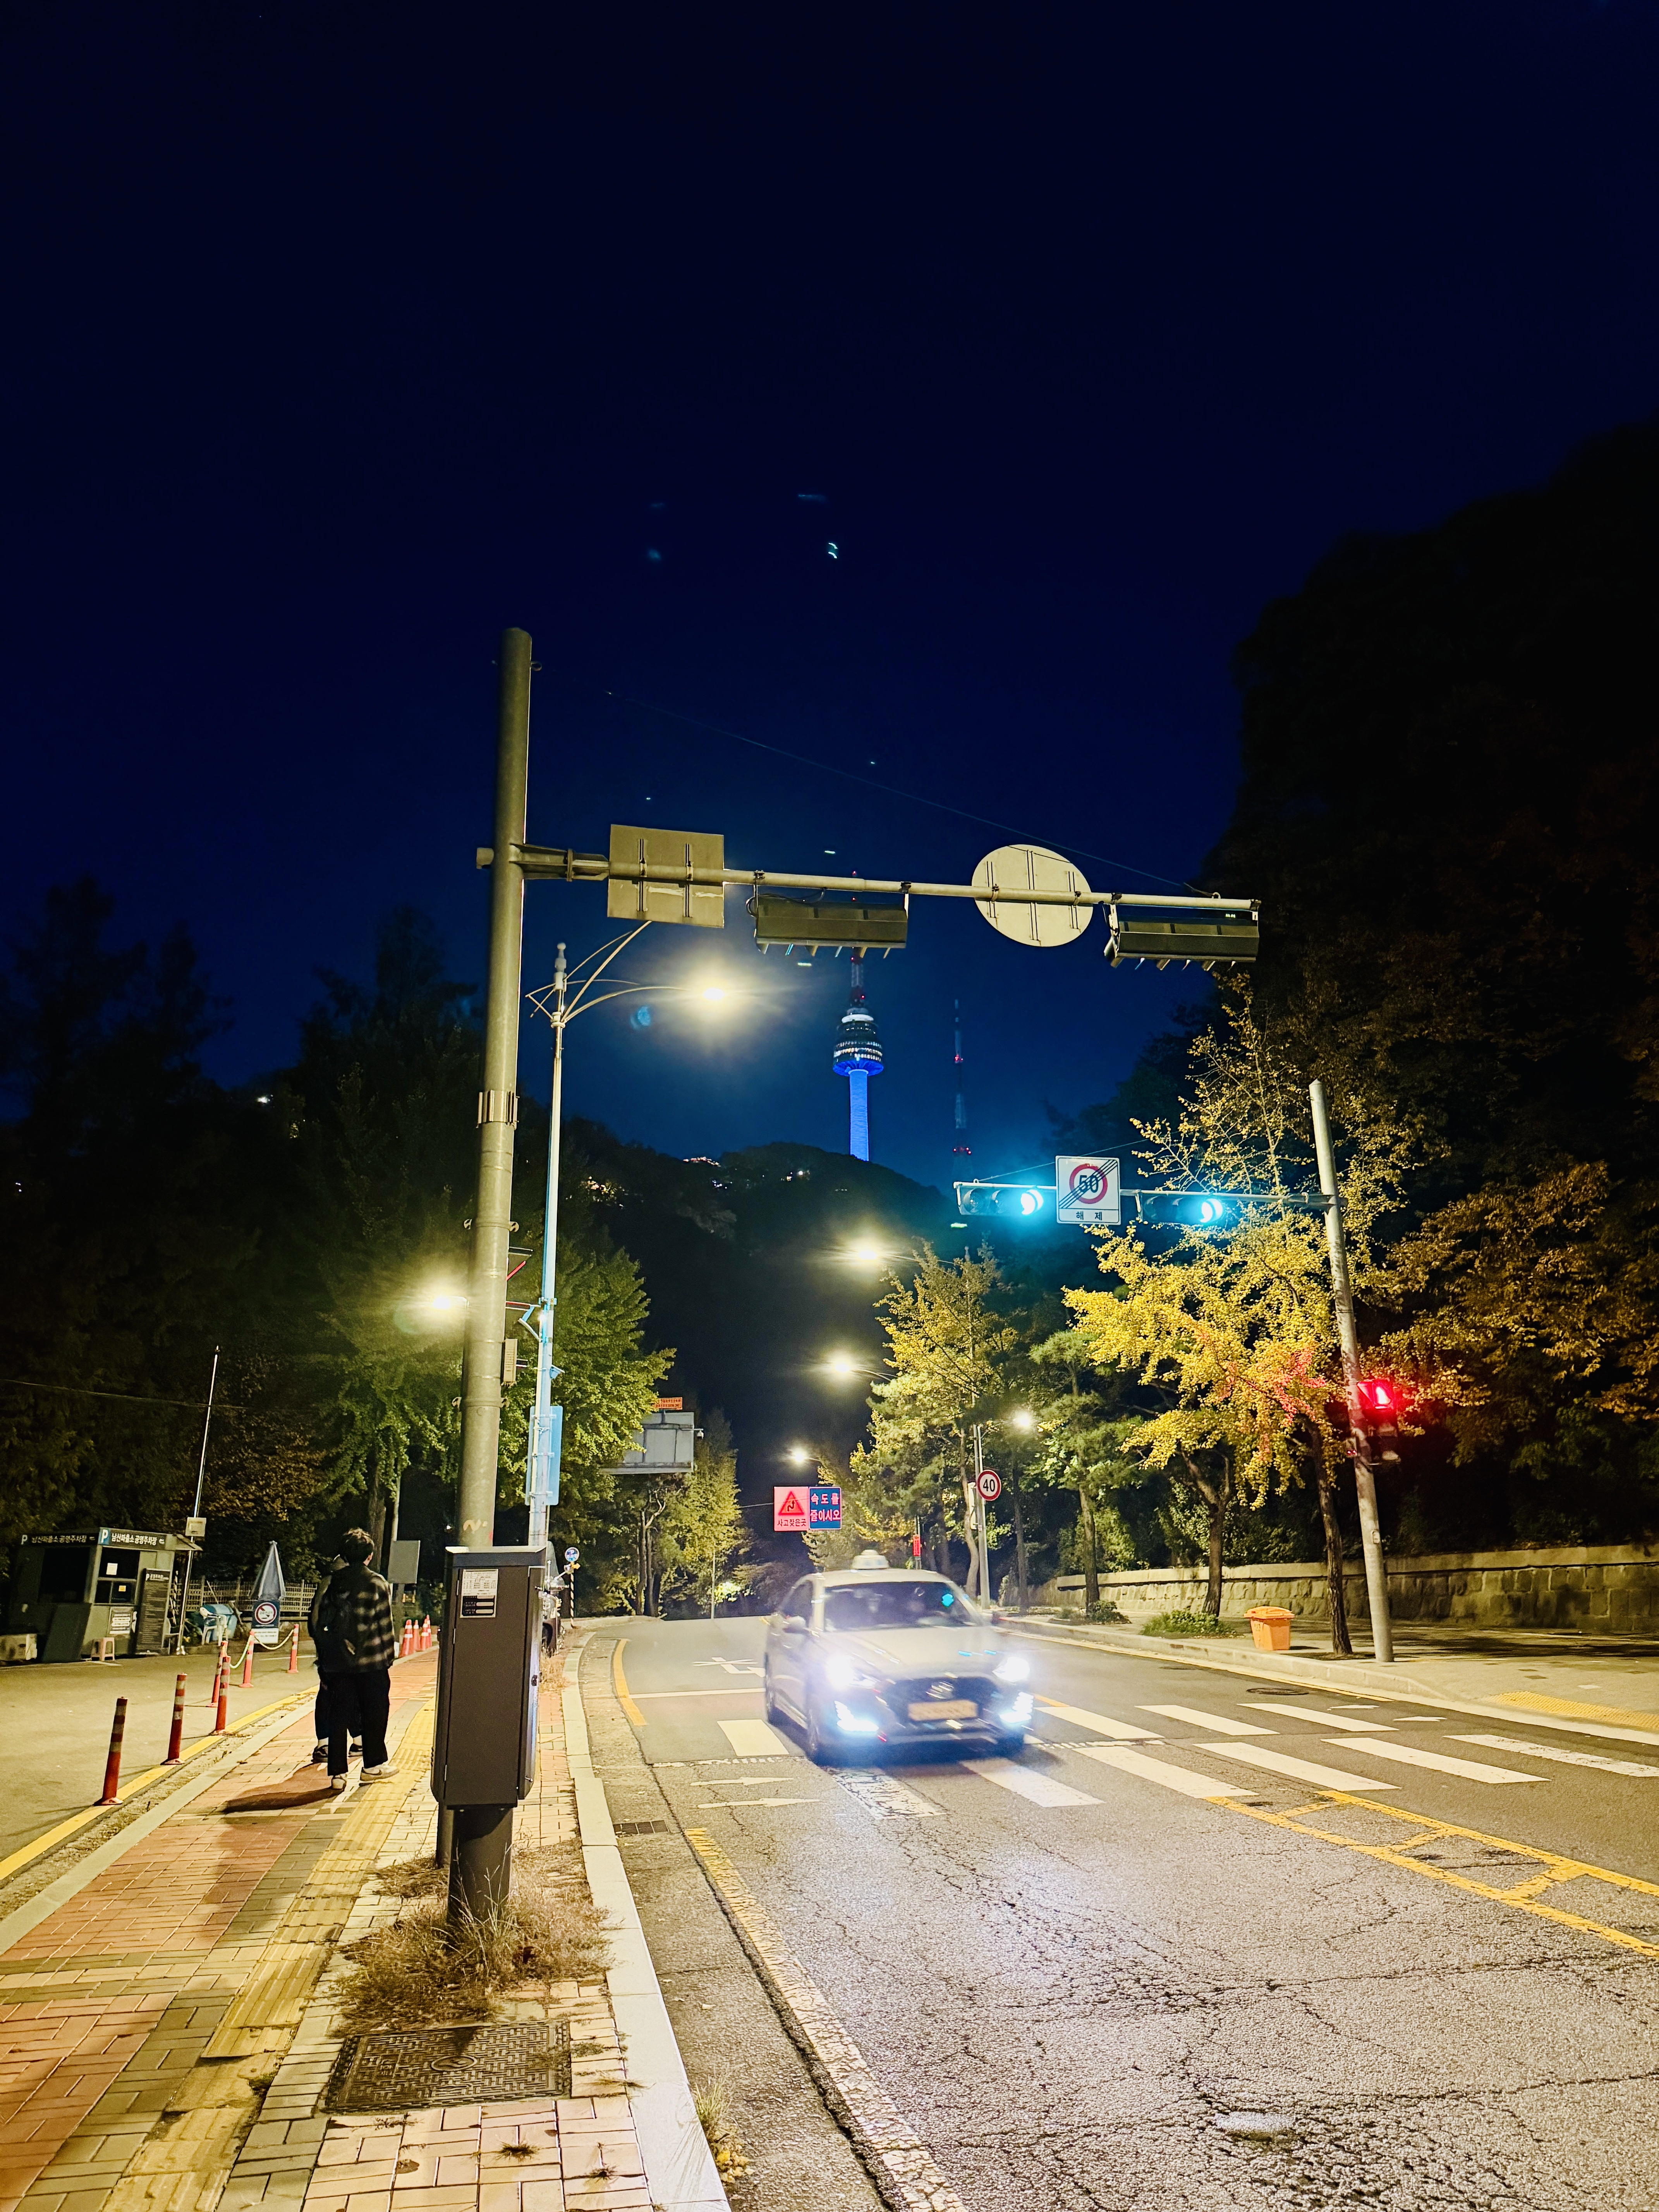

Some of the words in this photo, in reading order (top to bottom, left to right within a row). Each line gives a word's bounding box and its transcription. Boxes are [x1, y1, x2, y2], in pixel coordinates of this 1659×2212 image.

[1079, 1175, 1099, 1193] 50
[983, 1479, 995, 1492] 40
[810, 1509, 841, 1522] 줄이시오
[21, 1534, 28, 1545] P
[101, 1529, 108, 1543] P
